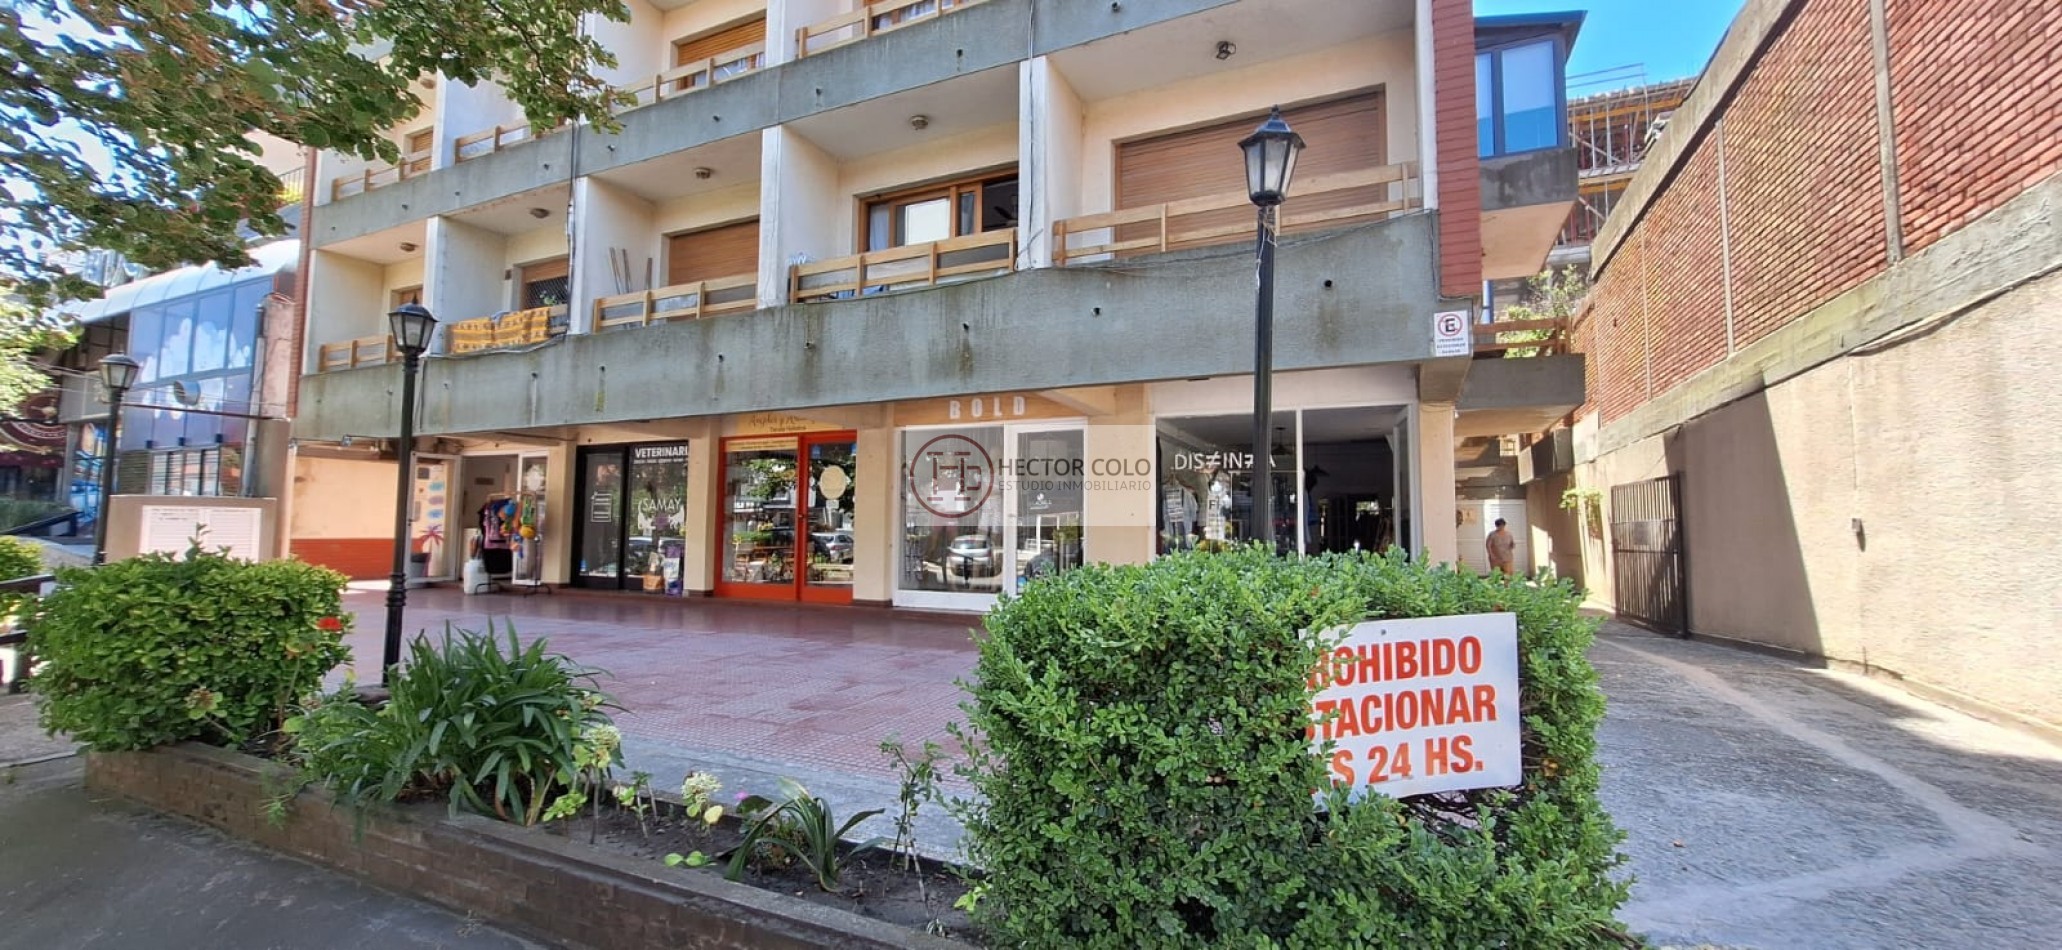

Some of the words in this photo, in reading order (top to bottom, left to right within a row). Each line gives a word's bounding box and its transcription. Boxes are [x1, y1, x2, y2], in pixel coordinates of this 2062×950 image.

[950, 396, 1025, 419] BOLD
[635, 445, 688, 458] VETERINARI
[643, 498, 681, 511] SAMAY
[1306, 636, 1482, 690] ROHIBIDO
[1305, 684, 1497, 741] TACIONAR
[1367, 742, 1412, 785] 24
[1425, 735, 1484, 776] HS.
